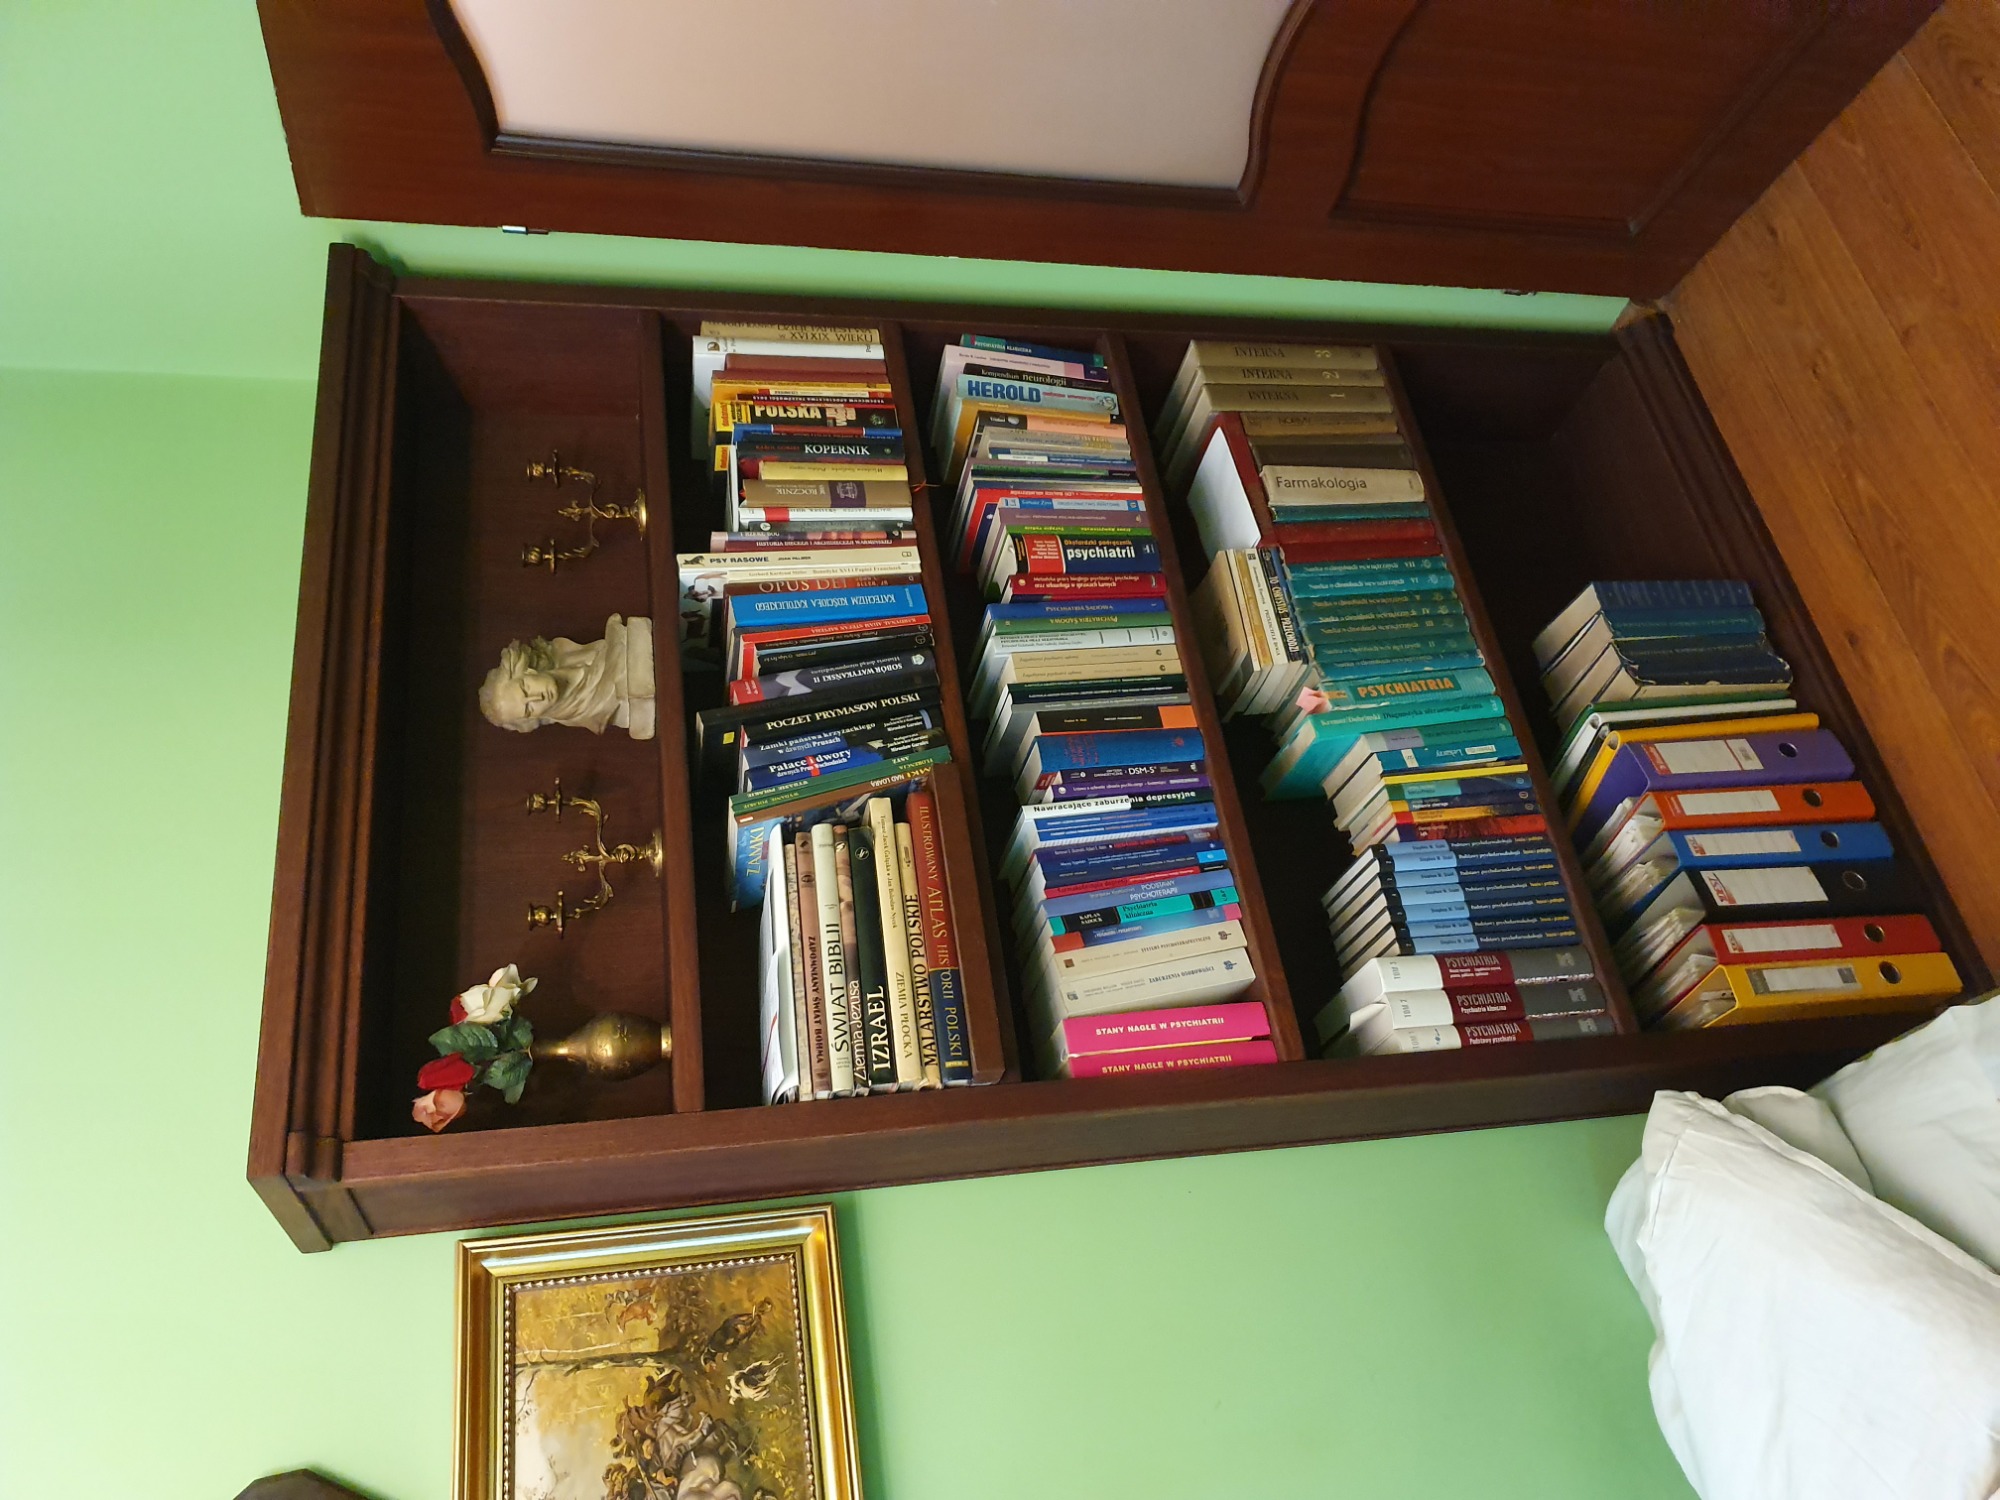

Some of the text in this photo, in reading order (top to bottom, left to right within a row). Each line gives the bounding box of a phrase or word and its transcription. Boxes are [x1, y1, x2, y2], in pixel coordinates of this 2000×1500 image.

[1235, 346, 1331, 359] INTERNA 3
[981, 369, 1067, 388] Kompendium neurologii
[1242, 368, 1340, 380] INTERNA 2
[967, 379, 1041, 403] HEROLD
[1248, 390, 1300, 402] INTERNA
[755, 403, 821, 419] POLSKA
[803, 443, 871, 456] KOPERNIK
[1275, 475, 1367, 492] Farmakologia
[776, 488, 818, 496] ROCZNIK
[1066, 546, 1136, 561] psychiatrii
[758, 580, 810, 593] OPUS
[755, 593, 896, 612] KATECHIZM KOŚCIOŁA KATOLICKIEGO
[1272, 586, 1288, 615] CHRYSTUS
[1280, 616, 1300, 654] PRZECHODZI
[813, 662, 903, 684] SOBÓR WATYKAŃSKI II
[1357, 677, 1455, 699] PSYCHIATRIA
[766, 713, 813, 731] POCZET
[882, 693, 921, 710] POLSKI
[1382, 709, 1423, 721] Diagnostyka
[759, 722, 877, 752] Zamki państwa krzyżackiego
[812, 736, 841, 749] Prusach
[768, 748, 852, 774] Pałace i dwory
[898, 758, 933, 770] FLORENCJA
[870, 773, 905, 788] NAD LOARĄ
[747, 786, 778, 798] POLSKIE
[770, 791, 800, 802] WYDANIE
[1033, 788, 1197, 815] Nawracające zaburzenia depresyjne
[746, 826, 765, 878] ZAMKI
[1140, 880, 1175, 892] PODSTAWY
[1129, 887, 1178, 902] PSYCHOTERAPII
[1122, 901, 1158, 912] Psychiatria
[1125, 909, 1154, 919] kliniczna
[1078, 912, 1101, 921] KAPLAN
[918, 804, 963, 1057] ILUSTROWANY ATLAS HISTORII POLSKI
[807, 935, 820, 994] ZAPOMNIANY
[1444, 954, 1500, 968] PSYCHIATRIA
[905, 894, 939, 1067] MALARSTWO POLSKIE
[1148, 972, 1181, 984] ZABURZENIA
[825, 923, 850, 1053] ŚWIAT BIBLII
[1456, 991, 1512, 1007] PSYCHIATRIA
[811, 995, 823, 1026] ŚWIAT
[895, 970, 913, 1059] ZIEMIA PŁOCKA
[1460, 1006, 1487, 1014] Psychiatria
[849, 979, 869, 1083] Ziemia Jezusa
[866, 985, 891, 1072] IZRAEL
[1095, 1026, 1124, 1036] STANY
[1127, 1023, 1157, 1033] NAGŁE
[1170, 1017, 1225, 1029] PSYCHIATRII
[1465, 1022, 1522, 1038] PSYCHIATRIA
[1469, 1034, 1516, 1045] Podstawy psychiatrii
[1101, 1064, 1131, 1074] STANY
[1134, 1061, 1164, 1071] NAGŁE
[1177, 1055, 1232, 1067] PSYCHIATRII
